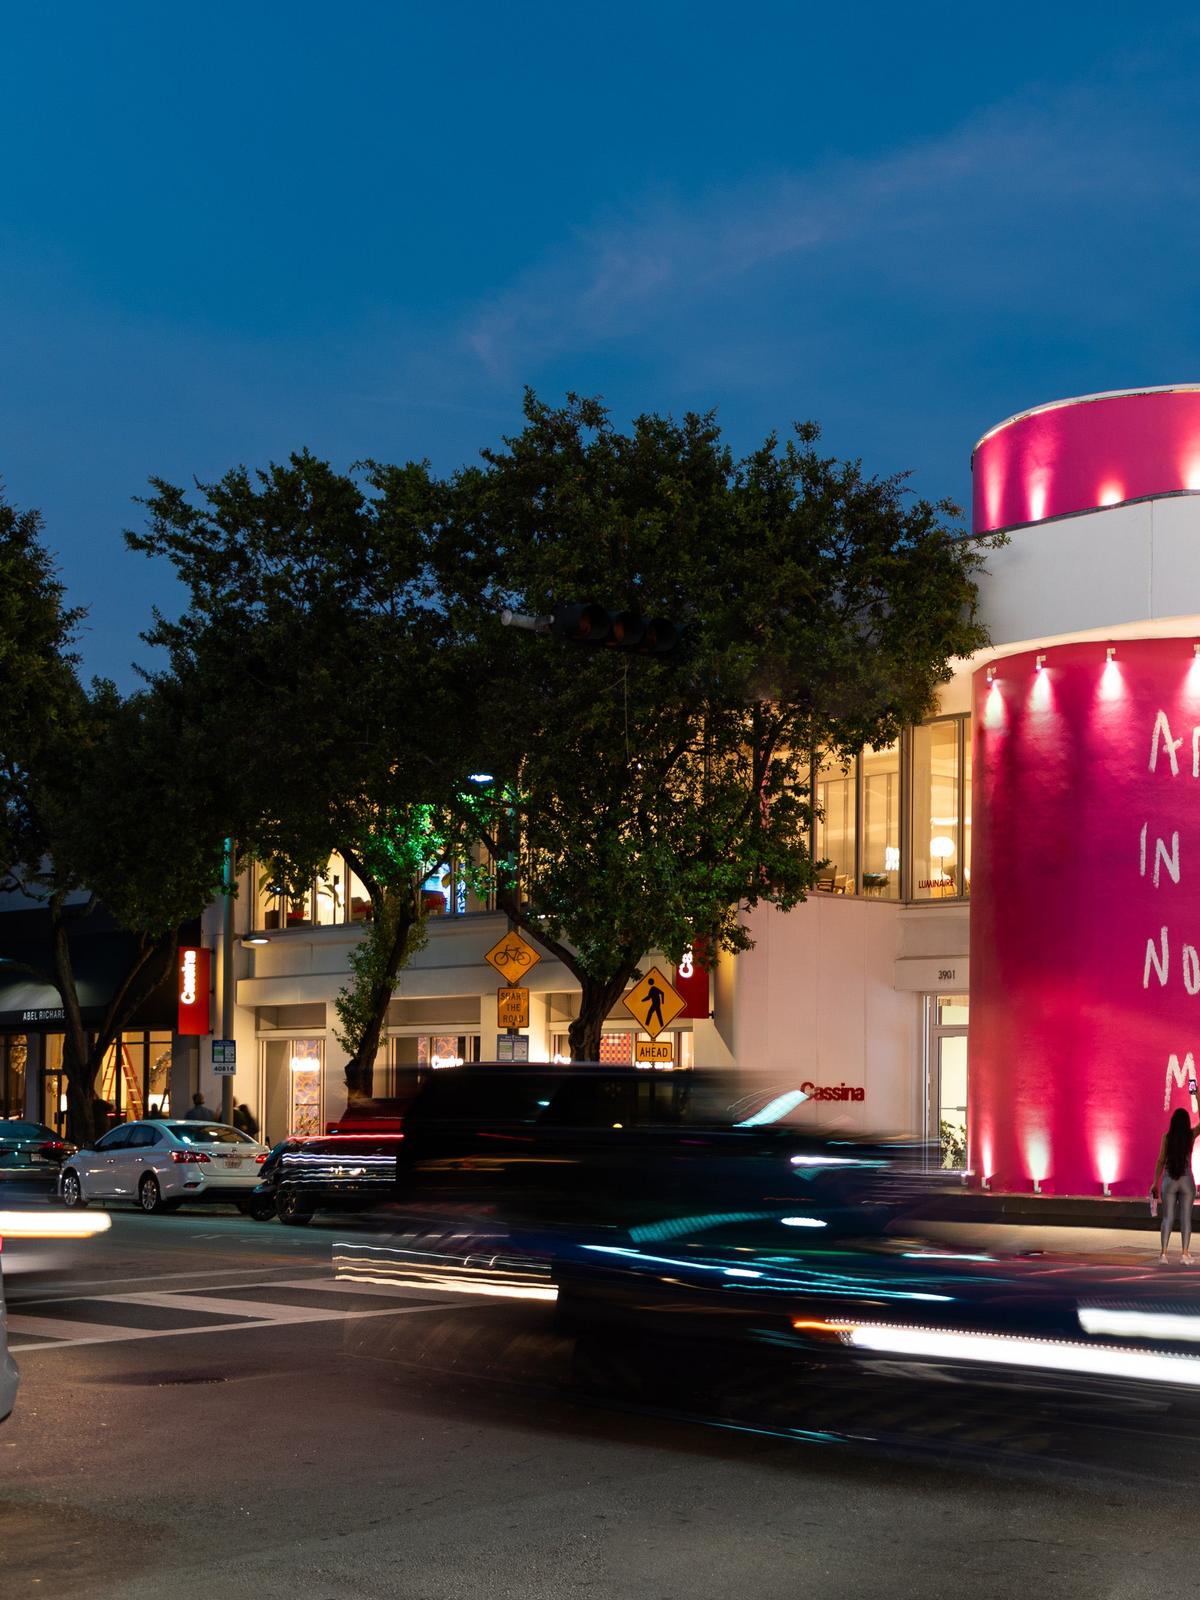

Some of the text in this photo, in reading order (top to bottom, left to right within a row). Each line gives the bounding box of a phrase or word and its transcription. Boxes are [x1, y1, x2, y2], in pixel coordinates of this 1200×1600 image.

[1139, 822, 1181, 888] IN
[918, 878, 955, 889] LUMINAIRE
[938, 970, 955, 980] 3901
[500, 992, 527, 1001] SHARE
[506, 1003, 521, 1012] THE
[22, 1011, 38, 1021] ABEL
[502, 1014, 524, 1023] ROAD
[640, 1047, 668, 1058] AHEAD
[800, 1081, 865, 1101] Cassina
